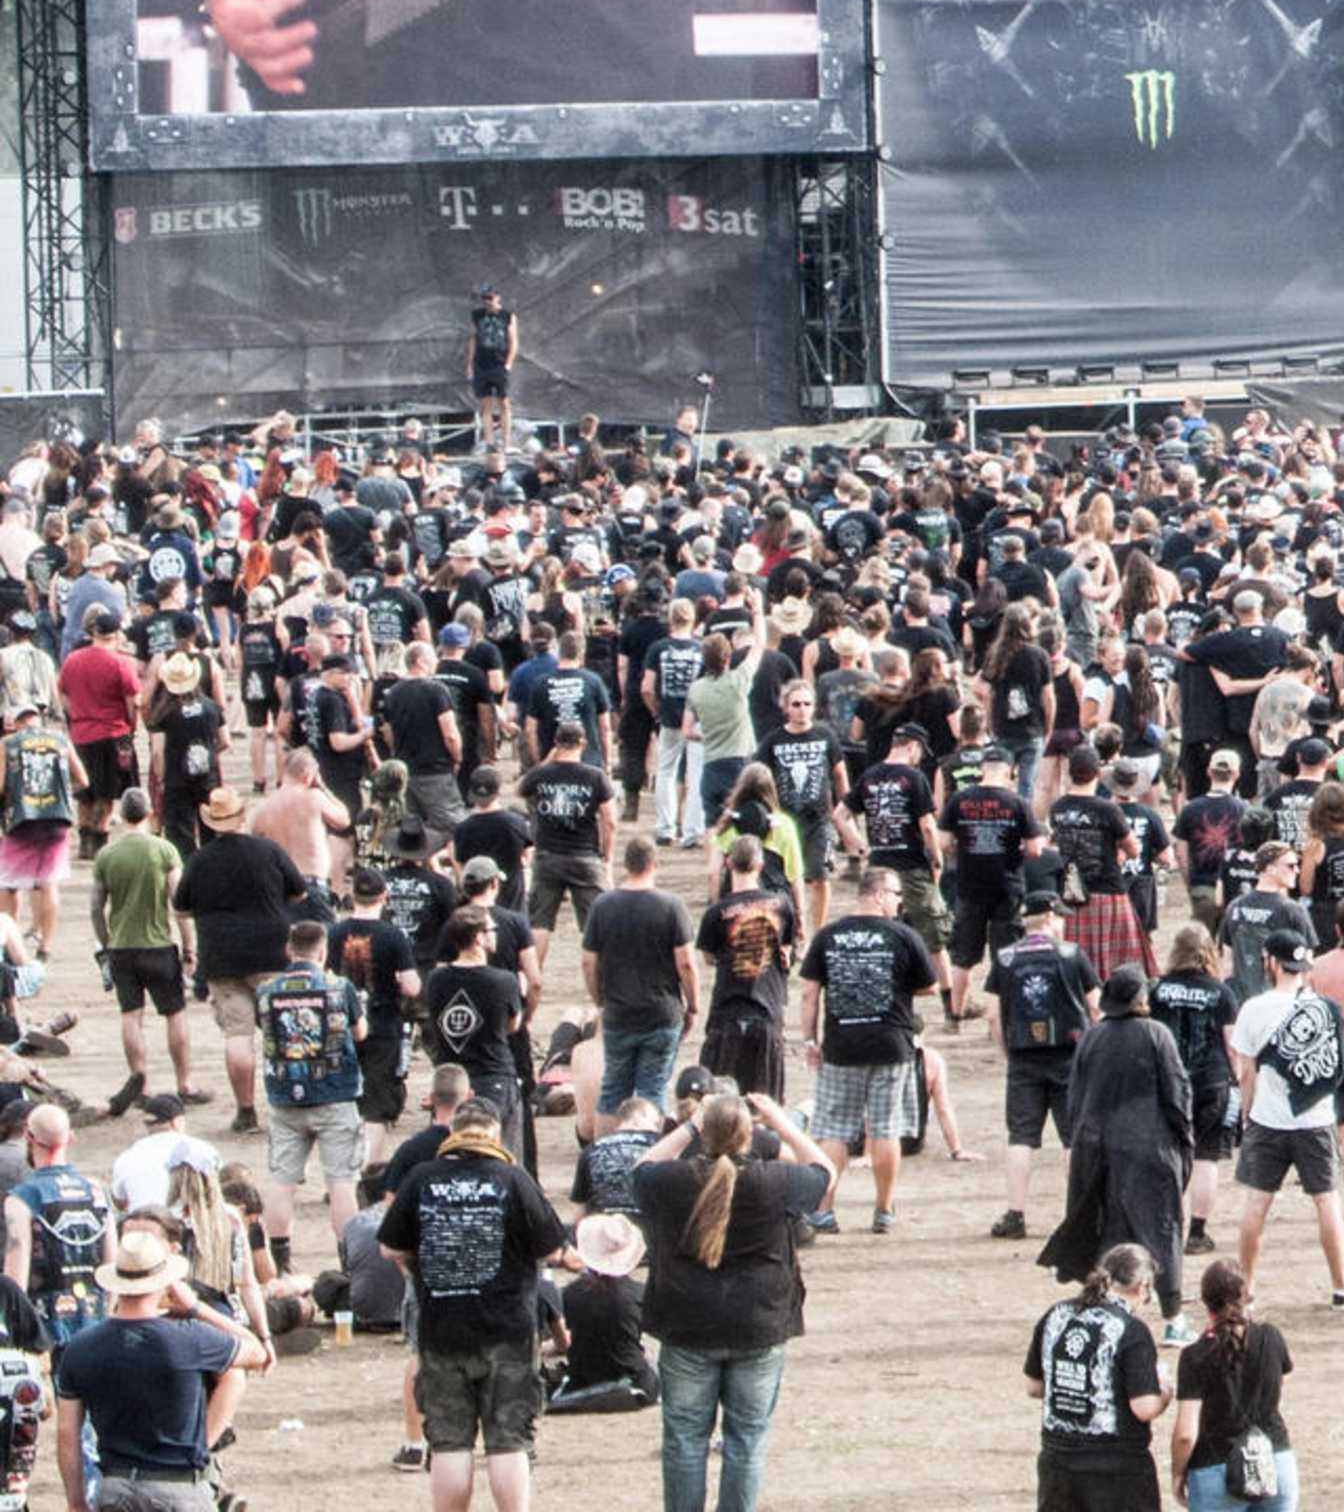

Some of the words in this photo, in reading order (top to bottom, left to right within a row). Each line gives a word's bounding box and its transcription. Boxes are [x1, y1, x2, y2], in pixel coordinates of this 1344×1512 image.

[151, 201, 263, 235] BECK'S
[562, 187, 645, 219] BOB!
[676, 194, 760, 237] 3sat
